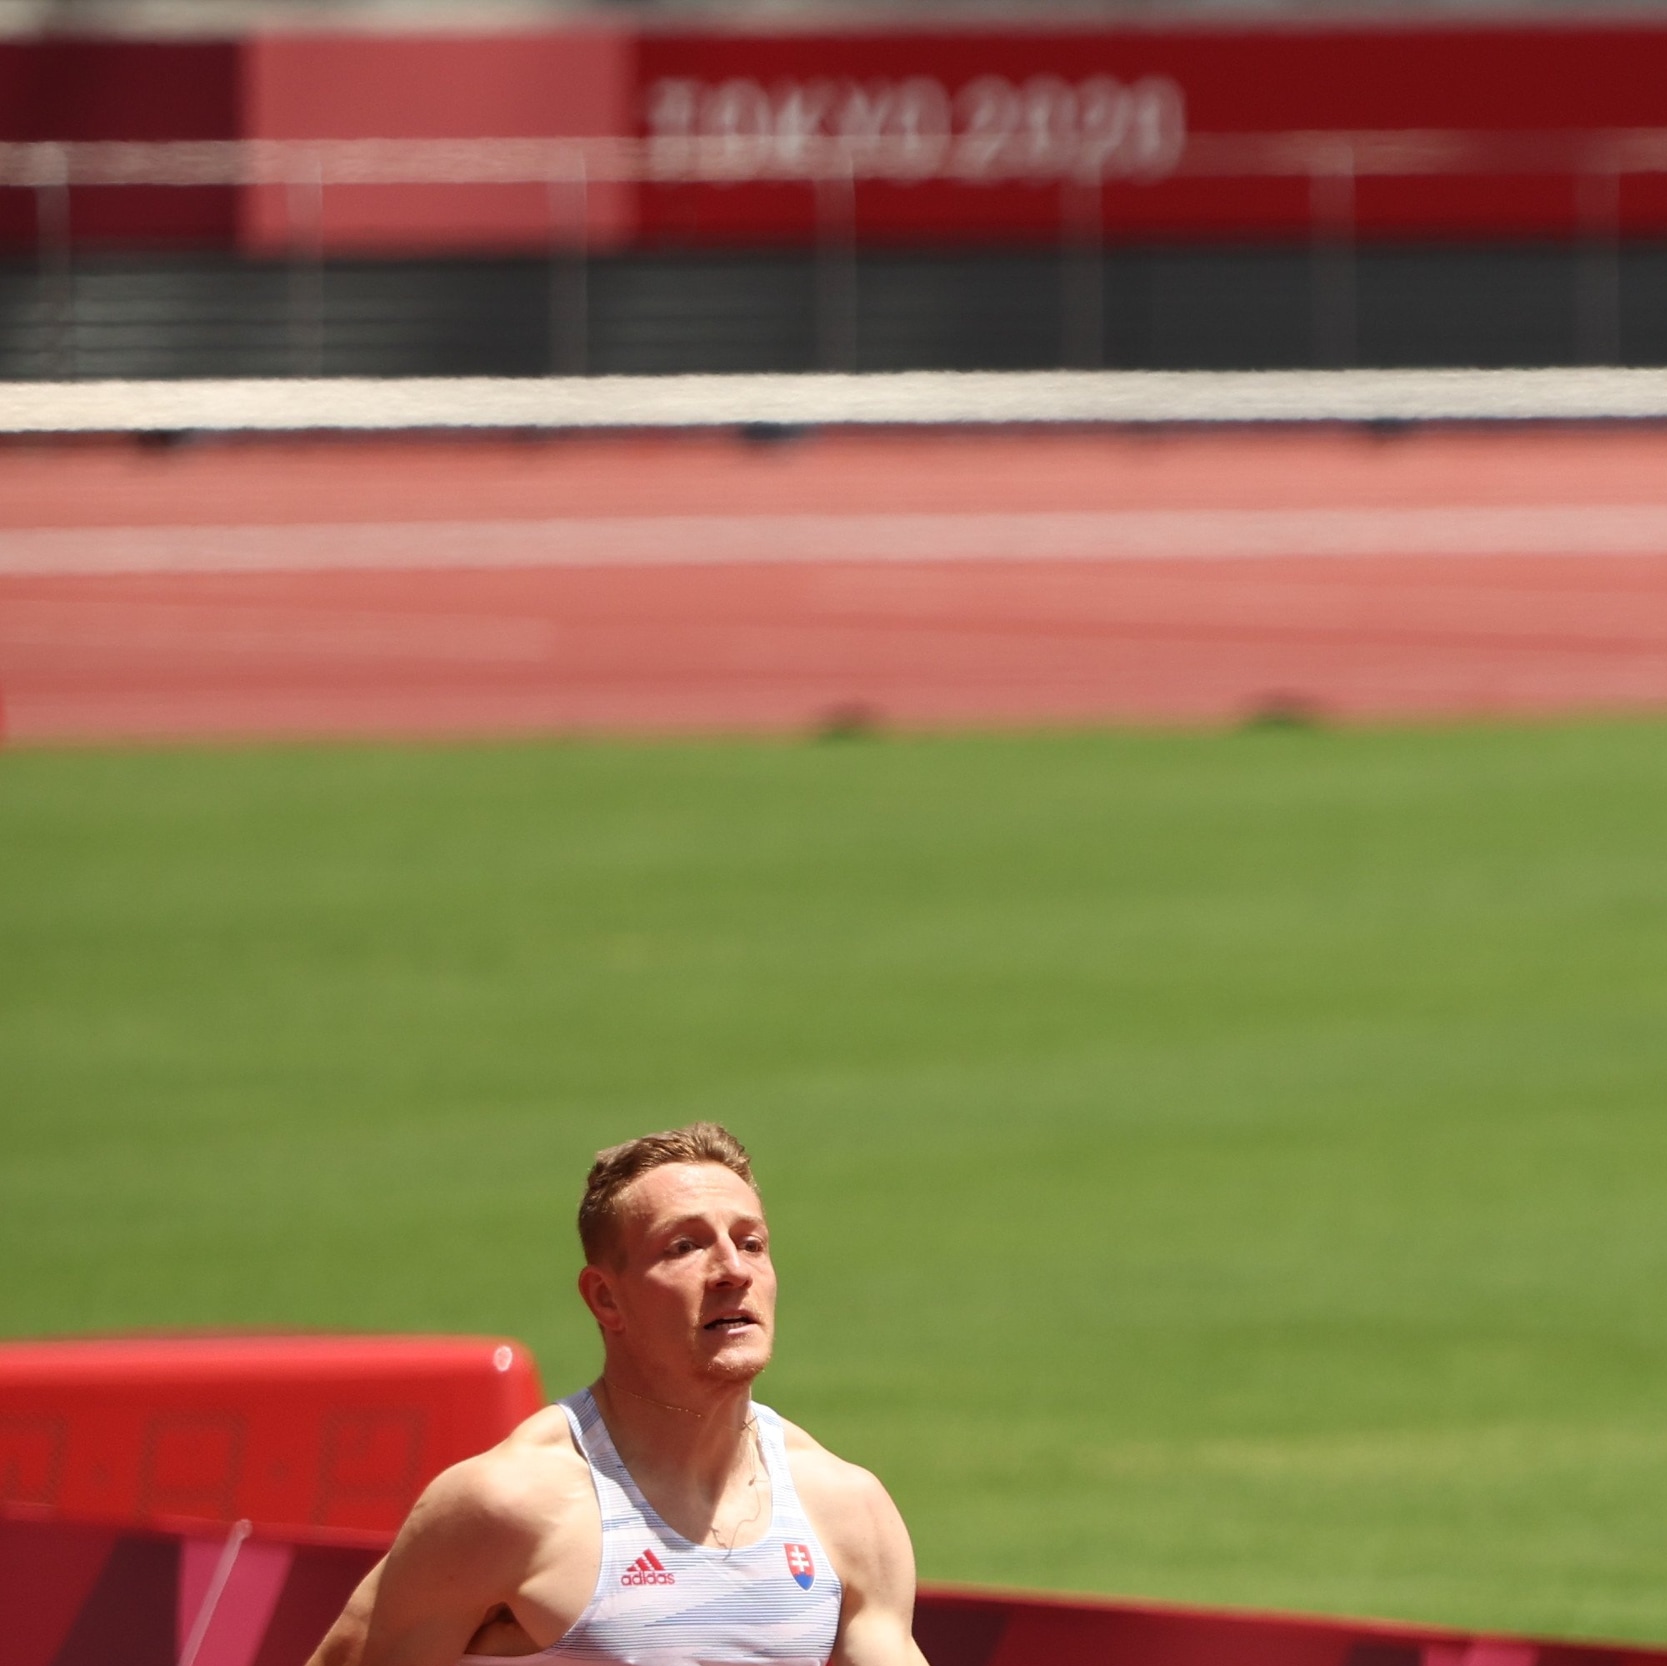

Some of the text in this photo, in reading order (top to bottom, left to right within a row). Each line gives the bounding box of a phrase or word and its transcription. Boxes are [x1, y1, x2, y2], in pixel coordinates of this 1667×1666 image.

[646, 74, 1188, 184] TOKYO 2020
[621, 1571, 675, 1586] adidas
